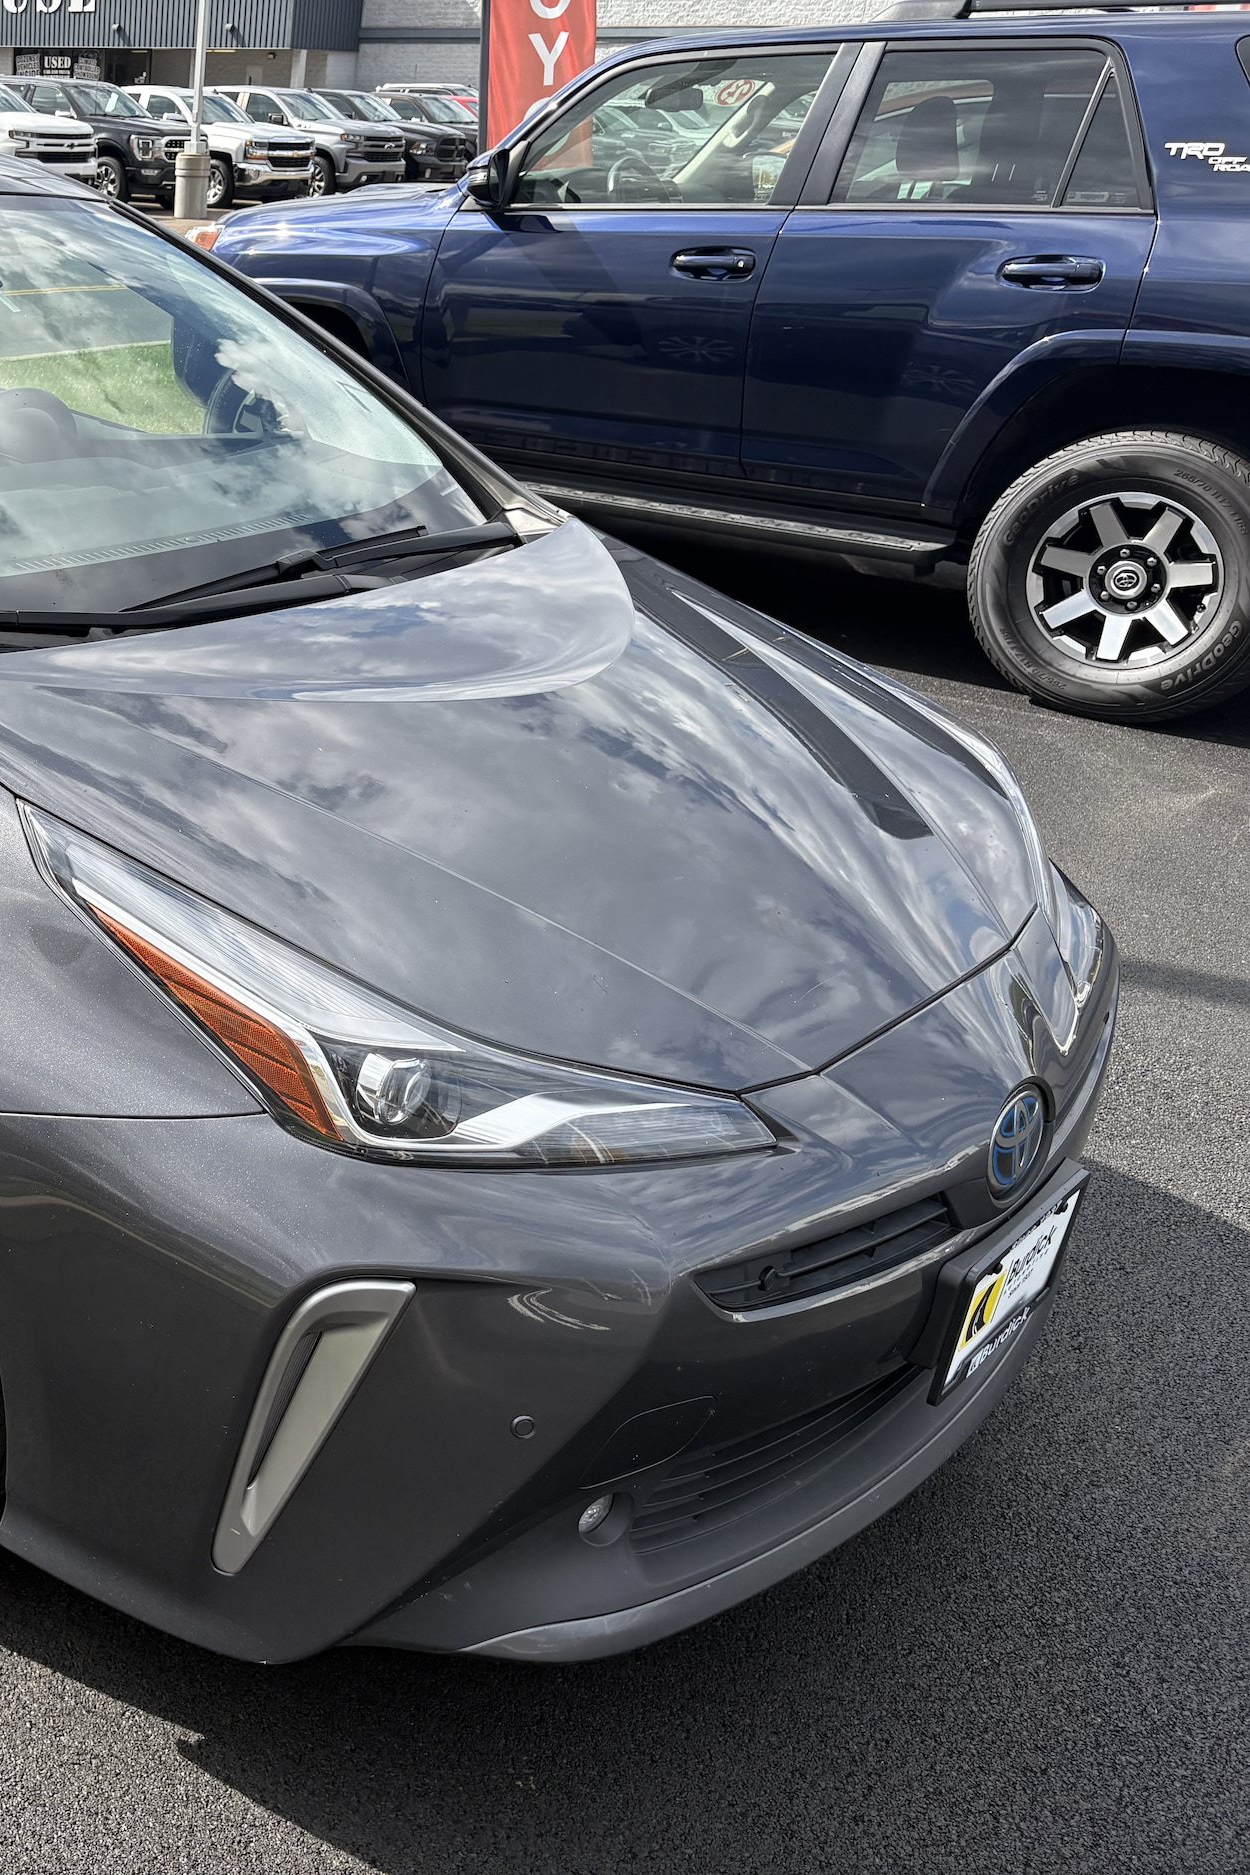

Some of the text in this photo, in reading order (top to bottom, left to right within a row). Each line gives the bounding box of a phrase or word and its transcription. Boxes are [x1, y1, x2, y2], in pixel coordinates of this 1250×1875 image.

[44, 56, 71, 68] USED
[1164, 142, 1226, 160] TRD
[1208, 156, 1248, 165] OFF
[1213, 164, 1250, 172] ROA
[1003, 474, 1079, 546] GeoDrive
[1160, 620, 1243, 691] GeoDrive
[1006, 1225, 1058, 1286] Burdick
[980, 1307, 1031, 1365] Burdick
